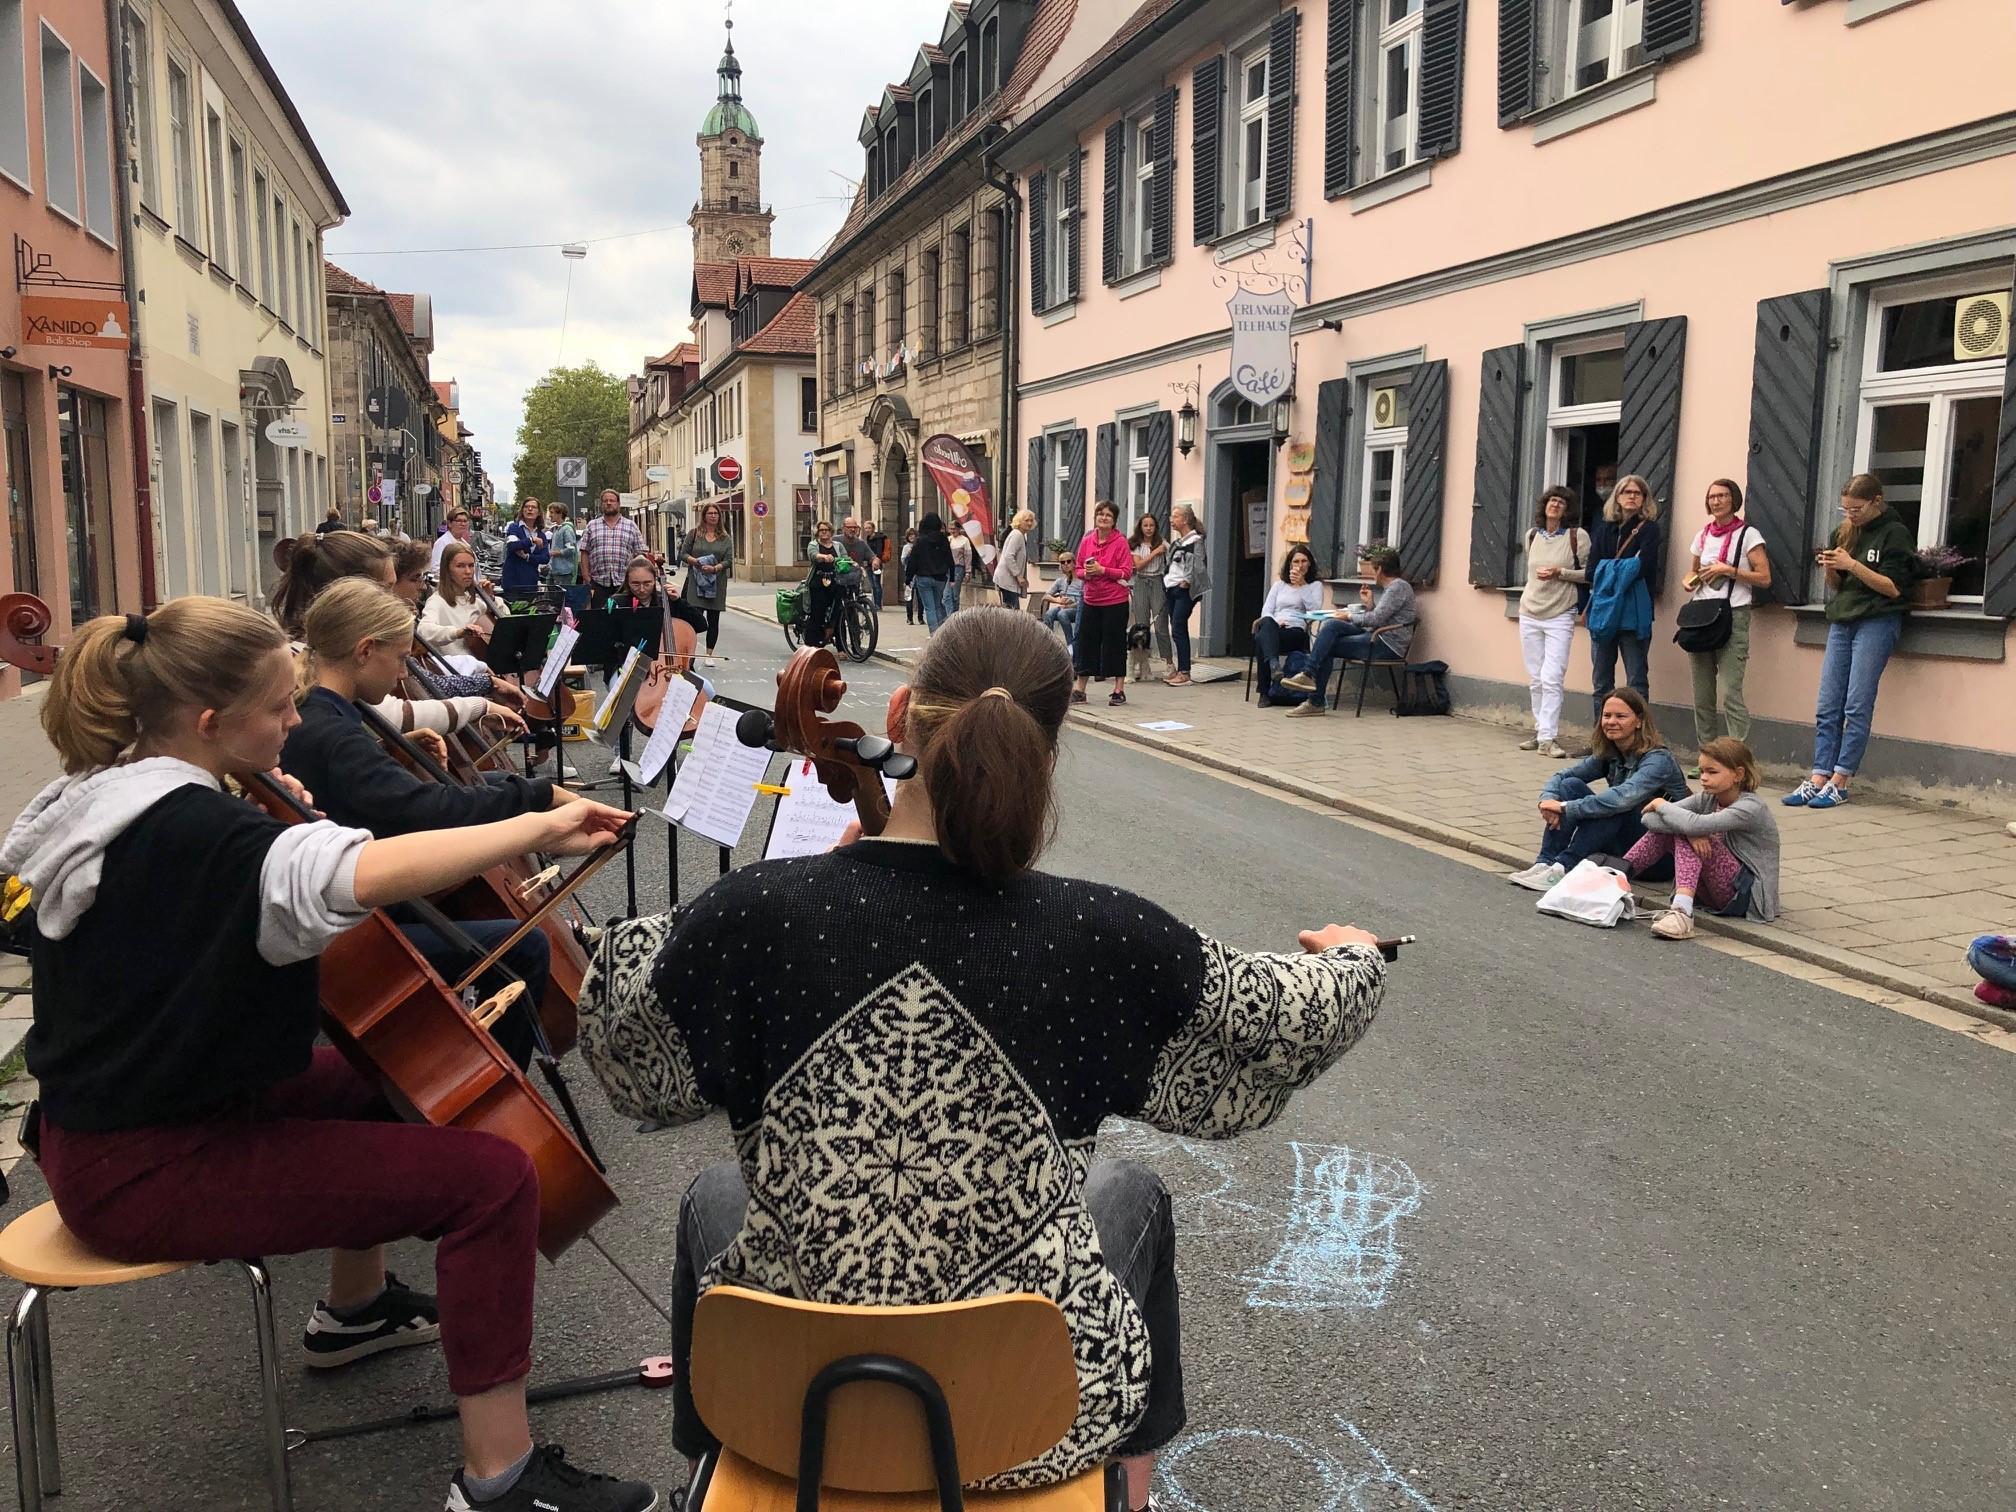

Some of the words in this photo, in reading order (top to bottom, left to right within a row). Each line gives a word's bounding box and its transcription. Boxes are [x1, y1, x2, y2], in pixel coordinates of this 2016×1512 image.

[27, 316, 97, 340] XANIDO
[1239, 321, 1287, 331] TEEHAUS
[46, 336, 64, 345] Bali
[66, 337, 92, 347] Shop
[1237, 364, 1284, 394] Café
[1867, 549, 1880, 563] 61
[533, 1499, 560, 1512] Reebok
